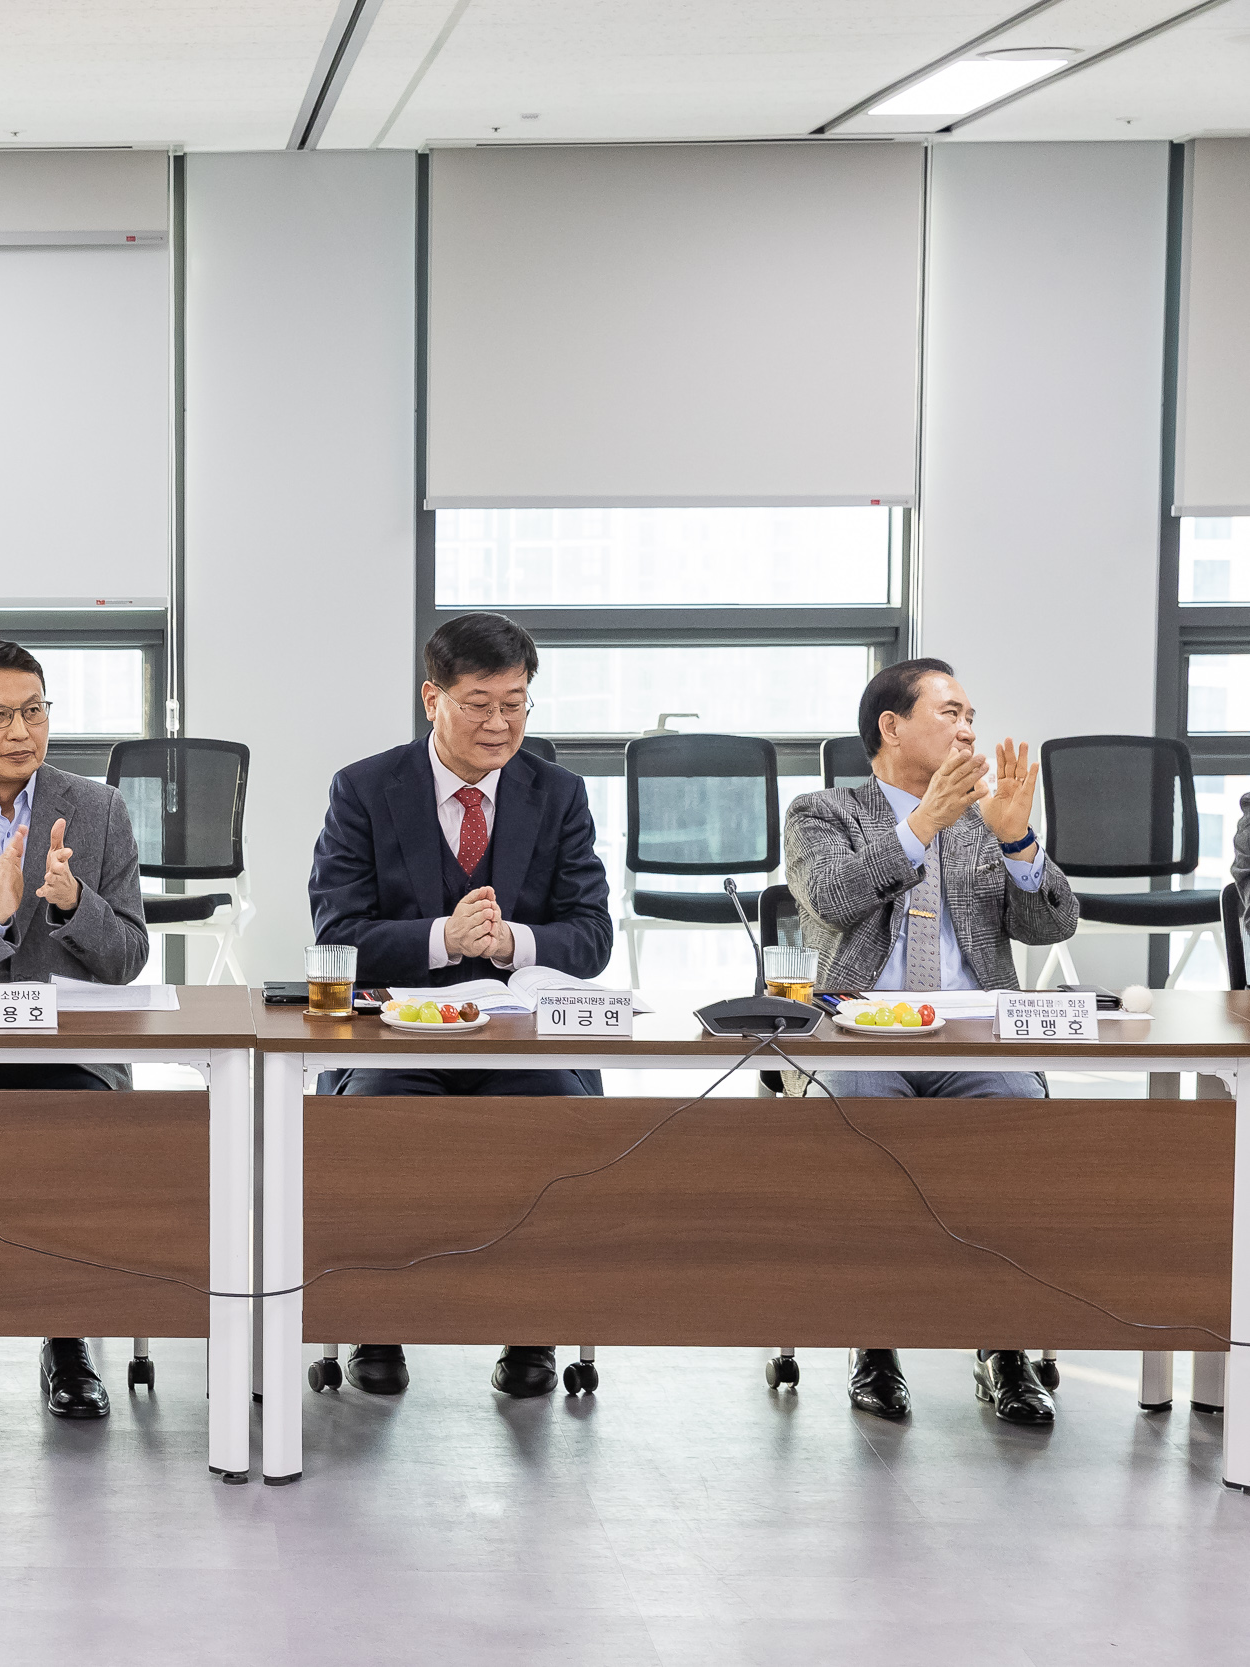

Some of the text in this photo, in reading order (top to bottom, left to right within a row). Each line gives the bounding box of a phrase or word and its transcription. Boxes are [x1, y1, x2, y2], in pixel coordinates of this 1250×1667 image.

[609, 997, 631, 1006] 교육장
[1068, 999, 1085, 1009] 회장
[1006, 1009, 1089, 1019] 통합방위협의회 고문
